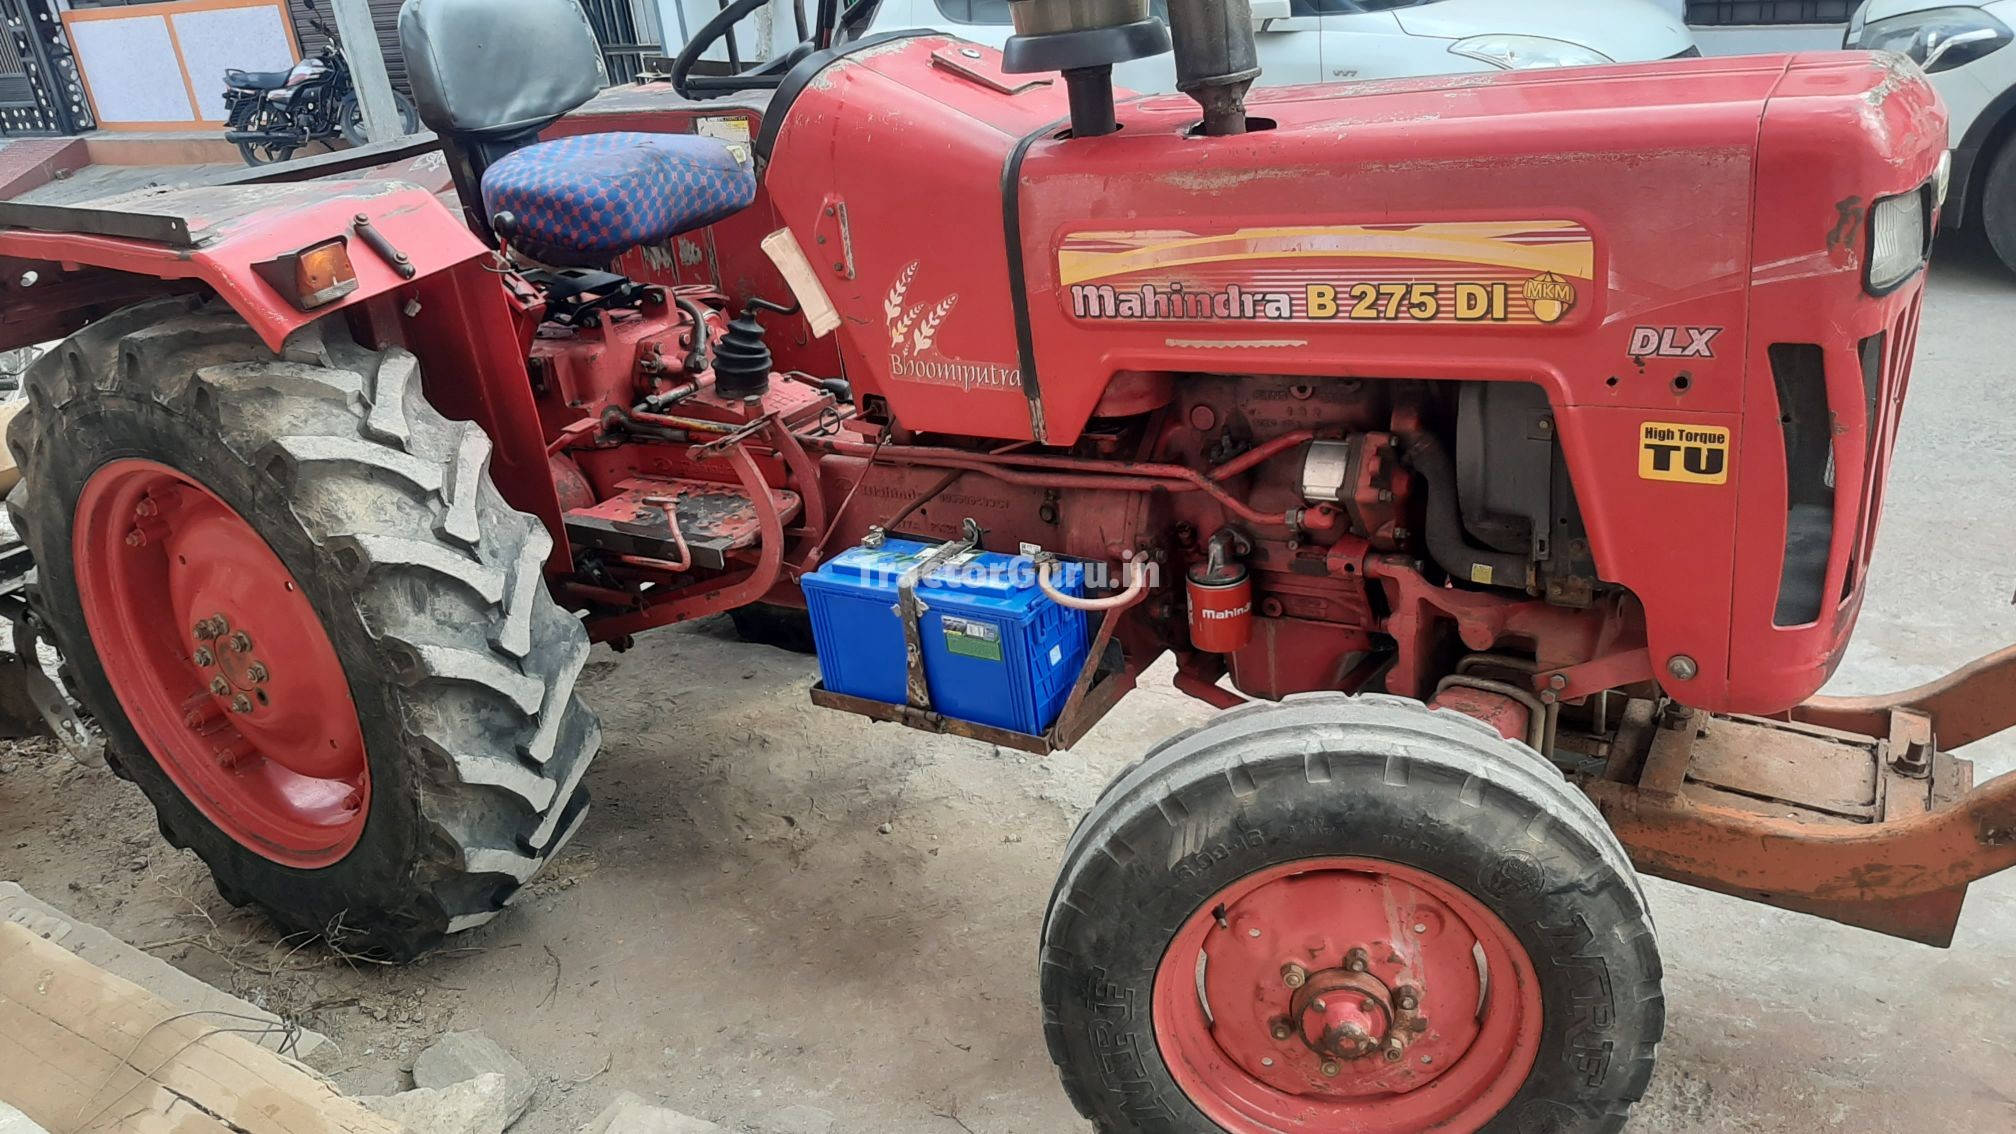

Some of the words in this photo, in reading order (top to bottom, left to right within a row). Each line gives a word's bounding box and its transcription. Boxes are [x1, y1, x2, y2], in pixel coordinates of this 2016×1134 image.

[1071, 282, 1292, 318] Mahindra
[1306, 283, 1338, 318] B
[1349, 283, 1438, 320] 275
[1455, 283, 1507, 319] DI
[1526, 280, 1570, 301] MKM
[1628, 326, 1723, 357] DLX
[890, 353, 1022, 391] Bhoomiputra
[1644, 426, 1675, 442] High
[1678, 429, 1726, 445] Torque
[1644, 444, 1725, 475] TU
